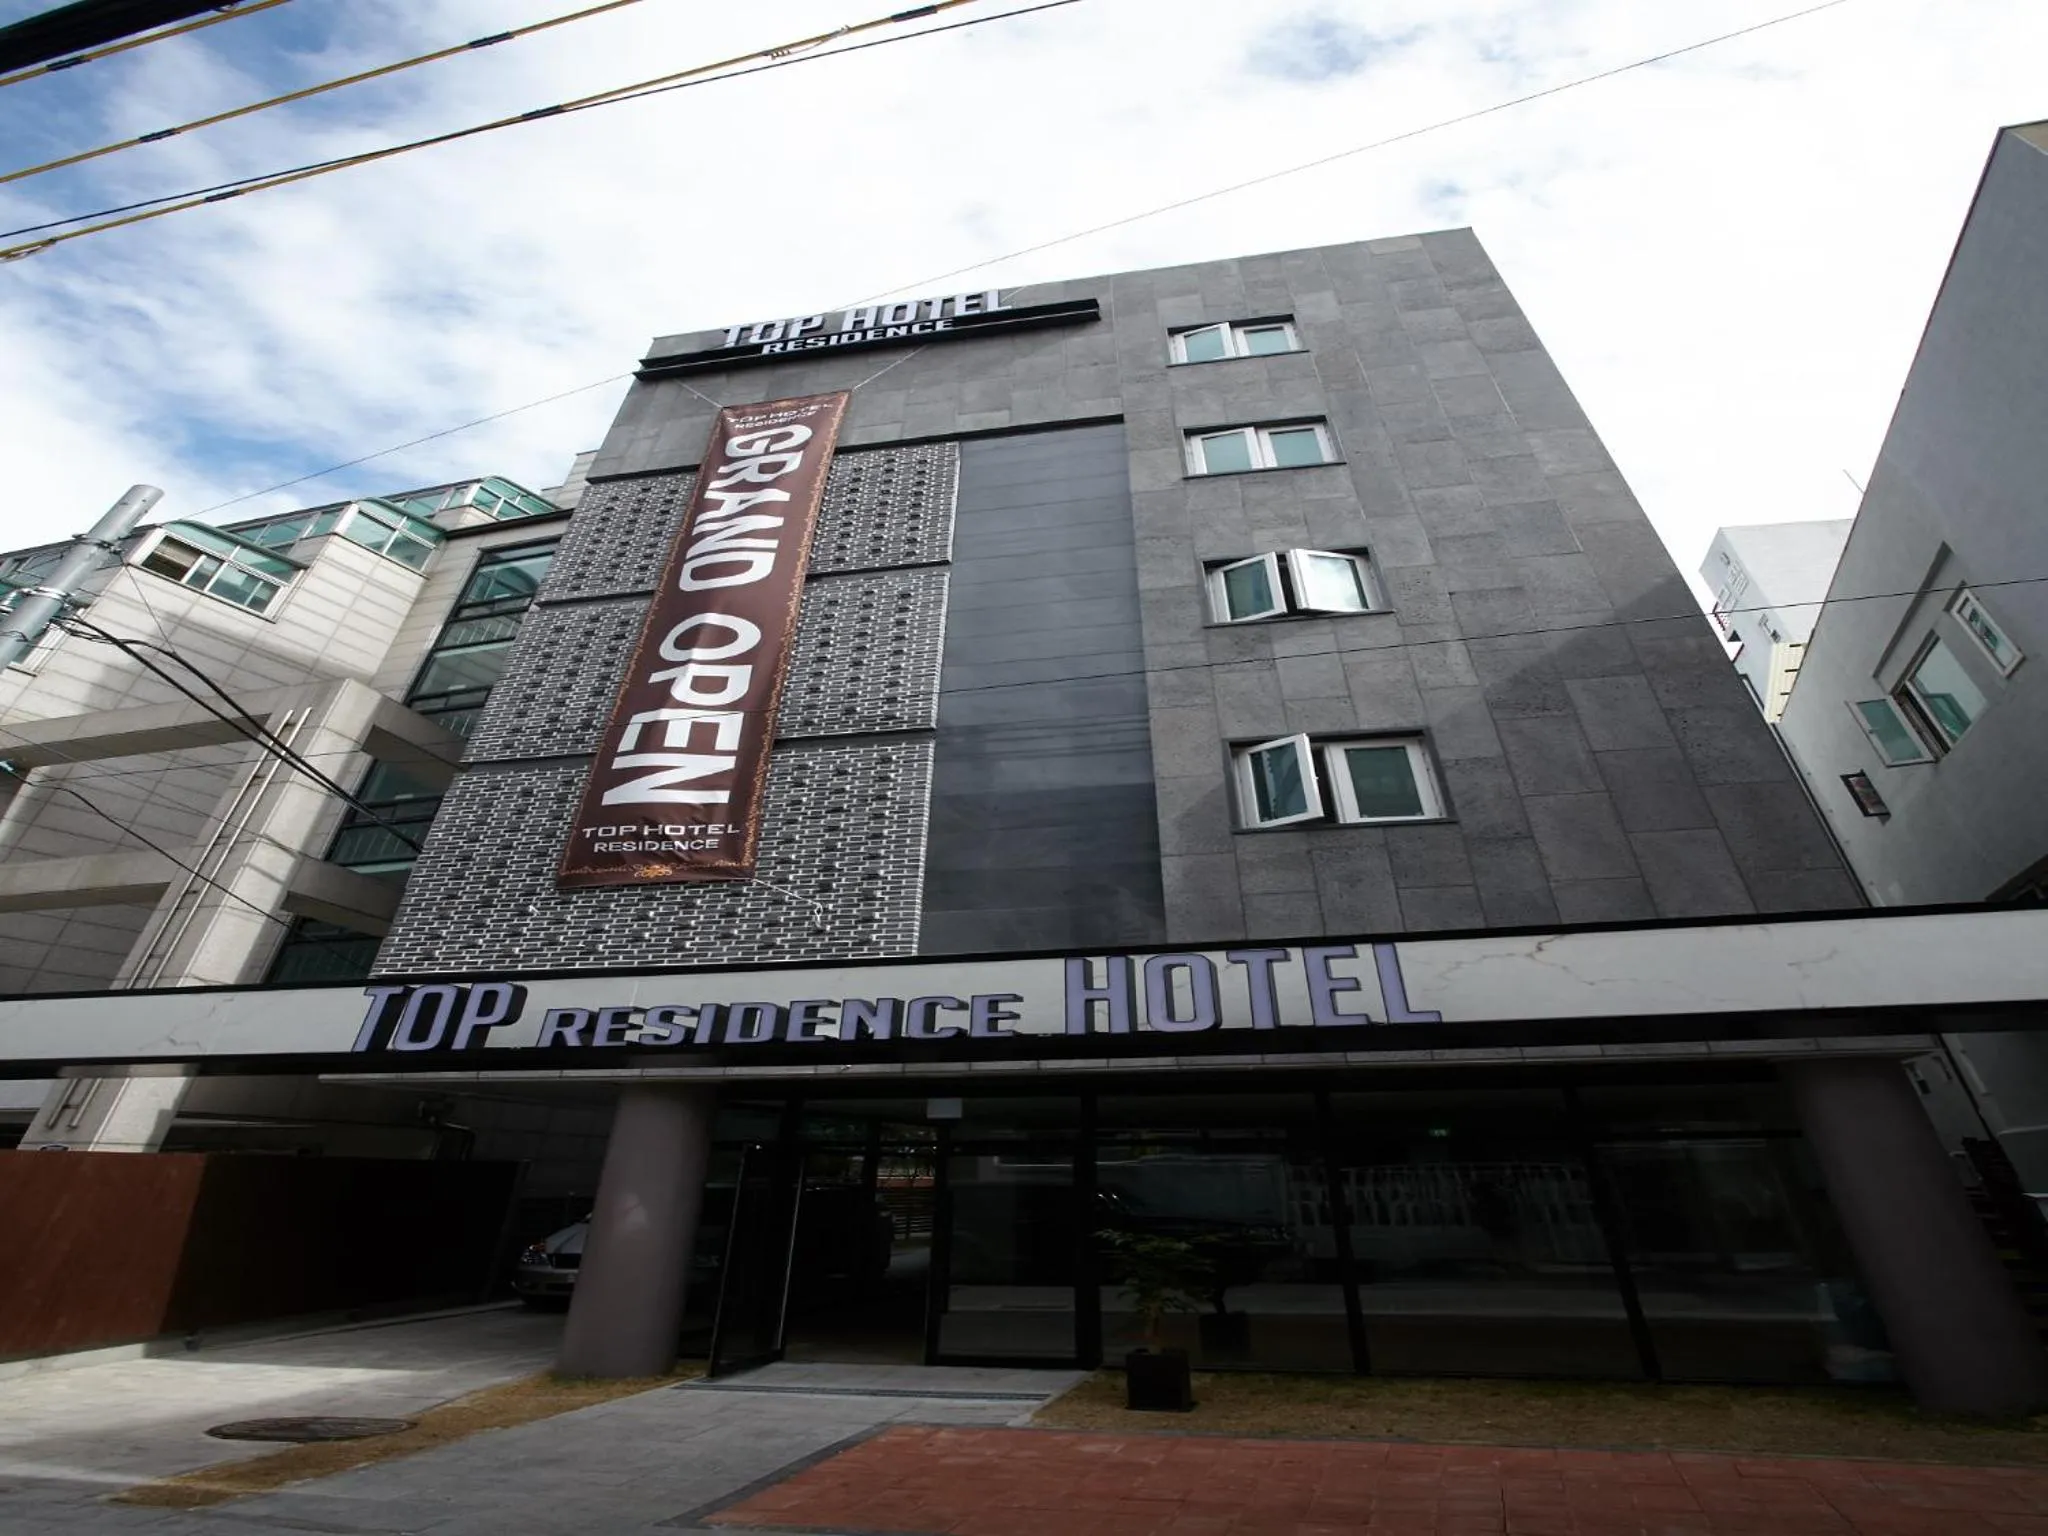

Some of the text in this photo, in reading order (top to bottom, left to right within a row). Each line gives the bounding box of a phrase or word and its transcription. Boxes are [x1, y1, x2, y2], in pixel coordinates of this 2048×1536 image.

[723, 289, 1012, 348] TOP HOTEL
[761, 319, 953, 354] RESIDENCE
[602, 424, 813, 806] GRAND OPEN
[582, 823, 740, 838] TOP HOTEL
[593, 838, 719, 853] RESIDENCE
[351, 942, 1443, 1053] TOP RESIDENCE HOTEL
